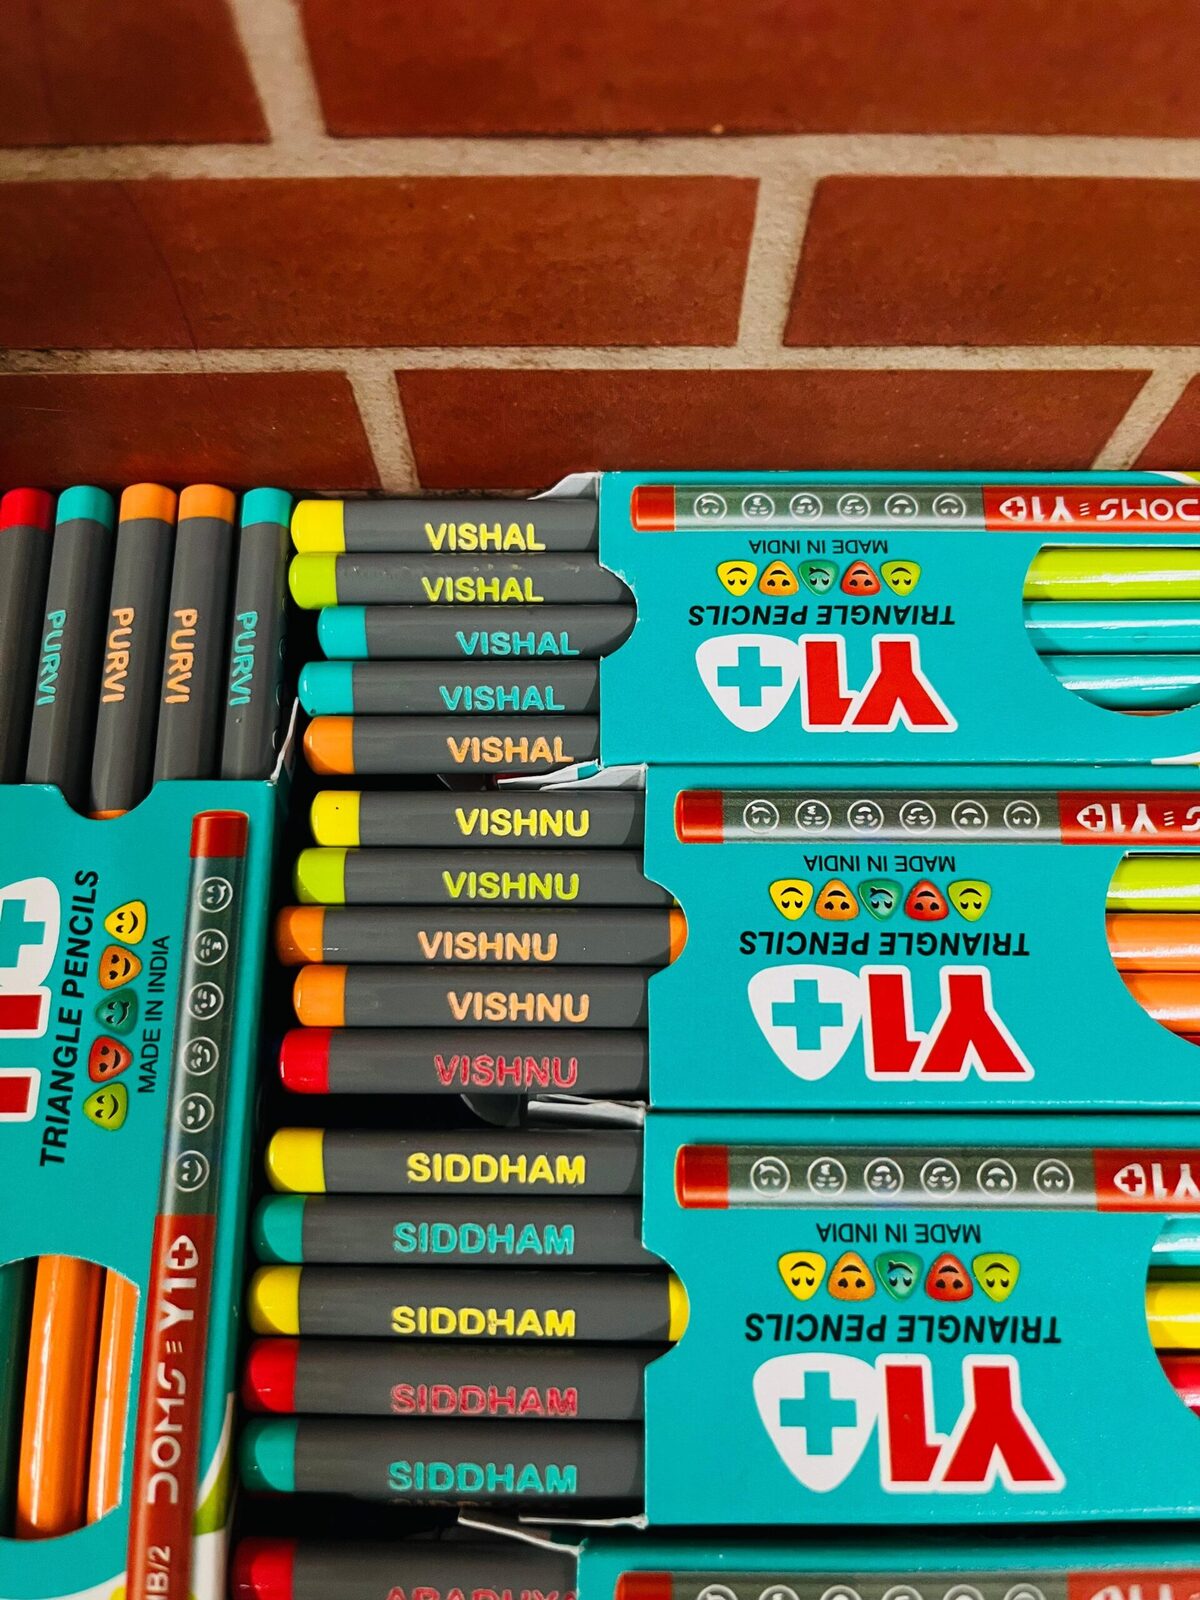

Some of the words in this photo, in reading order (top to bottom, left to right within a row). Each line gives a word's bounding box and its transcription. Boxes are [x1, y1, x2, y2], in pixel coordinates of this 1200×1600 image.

[424, 522, 546, 551] VISHAL
[748, 540, 800, 554] INDIA
[807, 540, 826, 554] IN
[832, 540, 889, 554] MADE
[421, 576, 544, 602] VISHAL
[688, 605, 808, 626] PENCILS
[816, 605, 955, 626] TRIANGLE
[36, 609, 66, 706] PURVI
[102, 607, 135, 703] PURVI
[165, 608, 198, 704] PURVI
[455, 631, 580, 656] VISHAL
[229, 610, 259, 707] PURVI
[439, 685, 566, 711] VISHAL
[446, 736, 575, 764] VISHAL
[455, 807, 590, 837] VISHNU
[803, 854, 861, 871] INDIA
[868, 854, 889, 871] IN
[894, 854, 956, 872] MADE
[442, 870, 580, 900] VISHNU
[417, 930, 558, 962] VISHNU
[739, 931, 870, 956] PENCILS
[879, 932, 1030, 956] TRIANGLE
[147, 935, 171, 993] INDIA
[39, 1006, 83, 1167] TRIANGLE
[62, 869, 100, 999] PENCILS
[144, 999, 164, 1022] IN
[447, 991, 590, 1023] VISHNU
[138, 1028, 162, 1093] MADE
[434, 1054, 579, 1089] VISHNU
[406, 1152, 587, 1185] SIDDHAM
[392, 1221, 576, 1256] SIDDHAM
[816, 1223, 878, 1243] INDIA
[886, 1224, 908, 1243] IN
[915, 1224, 982, 1244] MADE
[391, 1306, 577, 1338] SIDDHAM
[745, 1313, 885, 1343] PENCILS
[897, 1315, 1062, 1344] TRIANGLE
[389, 1384, 579, 1417] SIDDHAM
[146, 1361, 188, 1505] DOMS
[387, 1460, 578, 1494] SIDDHAM
[145, 1546, 170, 1600] B/2
